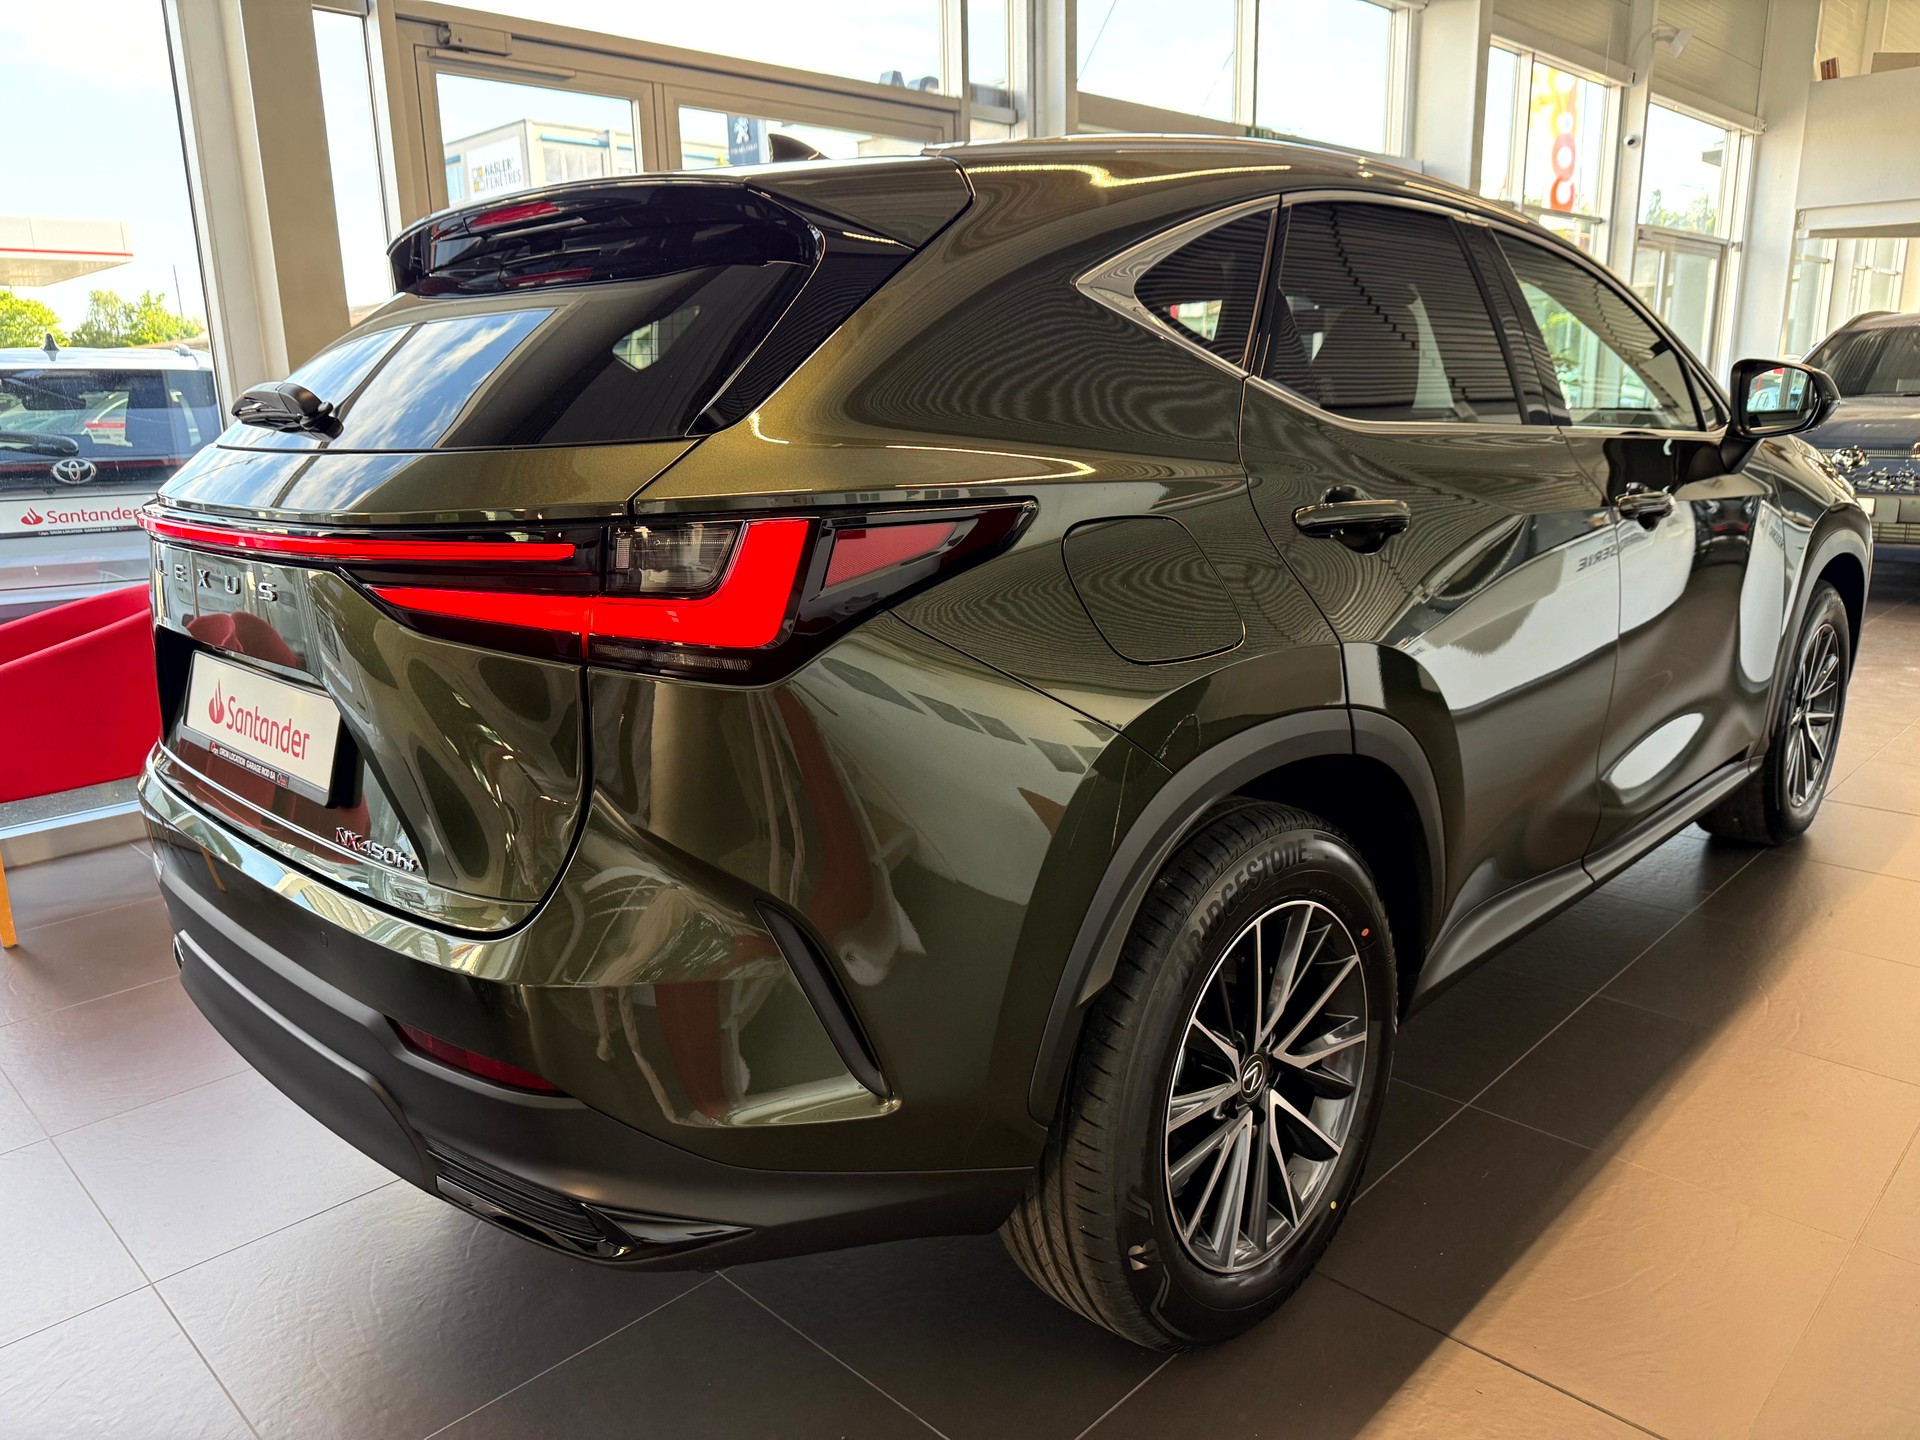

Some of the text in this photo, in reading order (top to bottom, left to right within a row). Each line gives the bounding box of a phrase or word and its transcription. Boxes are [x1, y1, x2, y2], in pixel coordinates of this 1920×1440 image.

[46, 507, 139, 525] Santander
[158, 559, 278, 602] LEXUS
[226, 696, 310, 760] Santander
